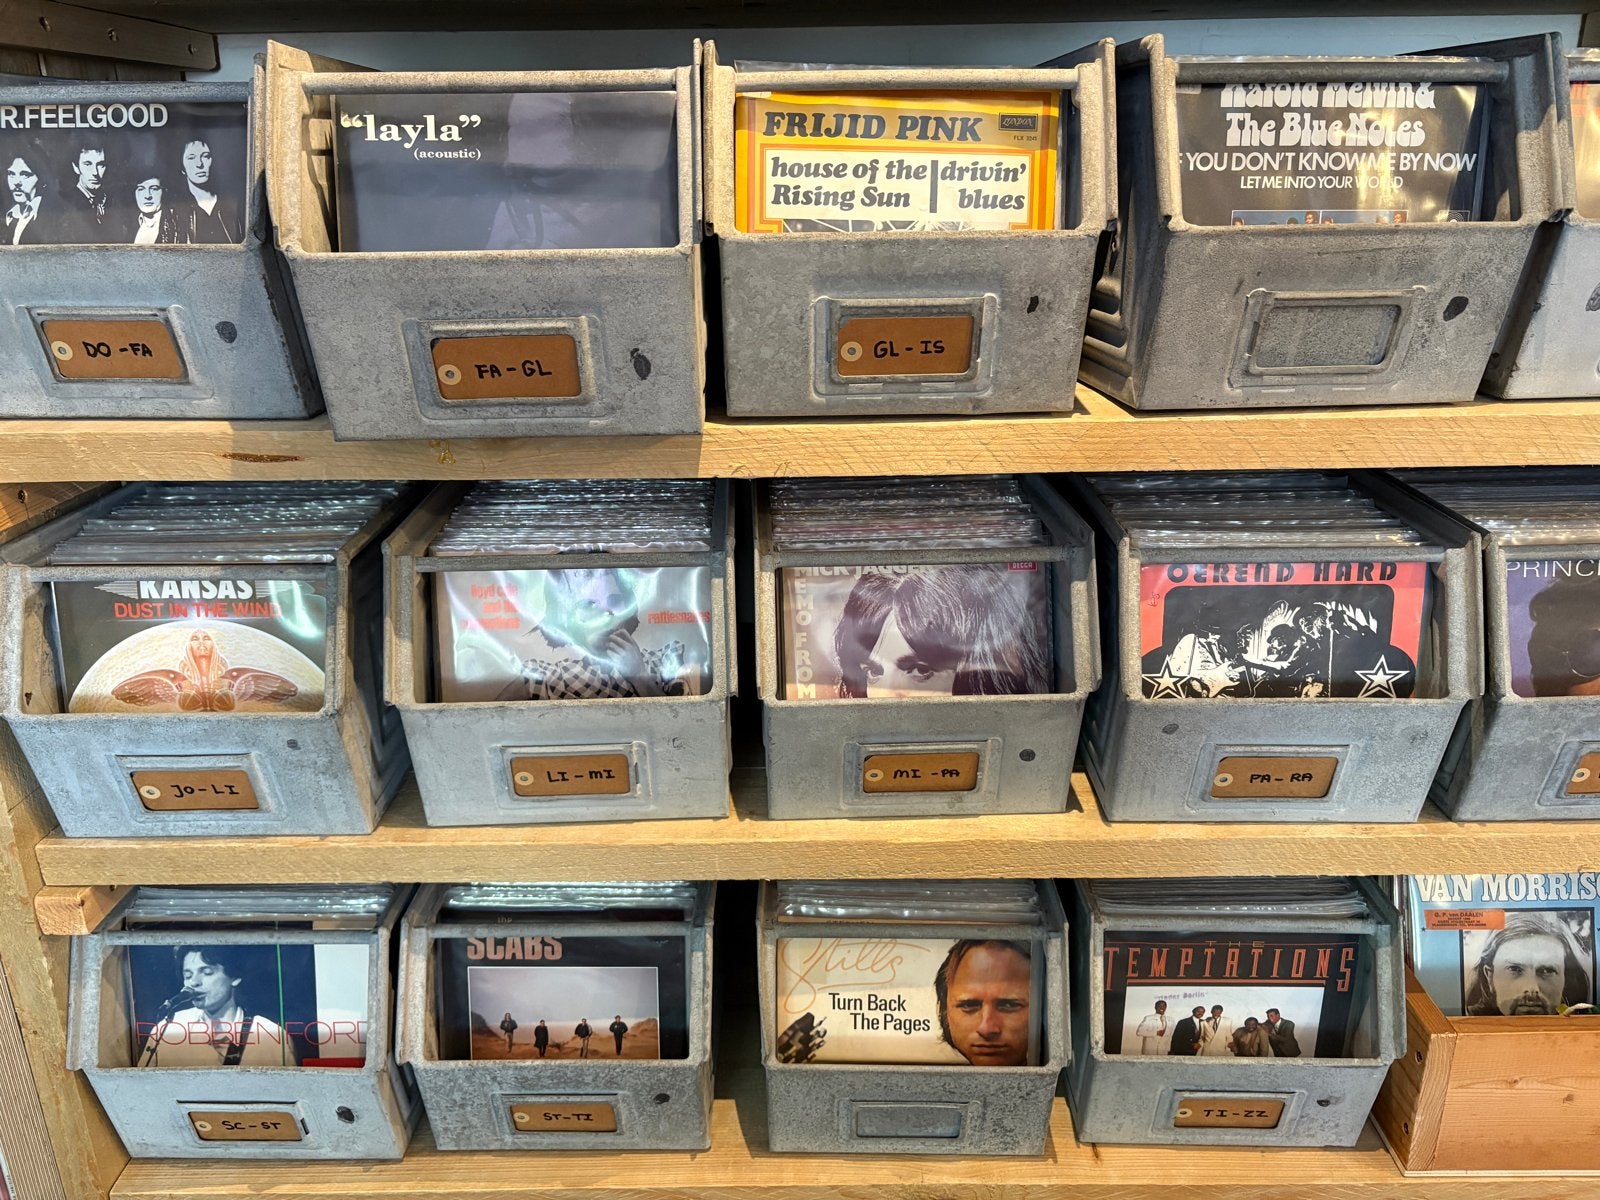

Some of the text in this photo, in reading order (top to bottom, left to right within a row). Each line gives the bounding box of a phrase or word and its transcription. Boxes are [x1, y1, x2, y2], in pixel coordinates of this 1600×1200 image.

[763, 111, 983, 141] FRIJID PINK
[1226, 112, 1426, 147] The Blue Notes
[413, 148, 482, 161] (acoustic)
[1185, 152, 1228, 171] YOU
[1298, 152, 1366, 171] KNOW
[1365, 152, 1397, 171] ME
[1399, 152, 1423, 171] BY
[1423, 152, 1477, 172] NOW
[770, 157, 928, 184] house of the
[1240, 175, 1404, 190] LET ME INTO YOUR WOD
[770, 184, 911, 211] Rising Sun
[957, 189, 1026, 210] blues
[794, 565, 930, 580] MICK JAGGE
[1313, 562, 1398, 582] HARD
[1506, 559, 1600, 578] PRINC
[139, 580, 253, 600] KANSAS
[114, 602, 282, 618] DUST IN THE WIND
[647, 610, 712, 625] rattlesnaes
[1413, 873, 1600, 902] VAN MORRIS
[467, 936, 563, 960] SCABS
[1205, 940, 1265, 948] THE
[1104, 947, 1355, 992] TEMPTATIONS
[828, 992, 907, 1012] Turn Back
[135, 1021, 281, 1046] ROBBEN
[850, 1013, 931, 1036] The Pages
